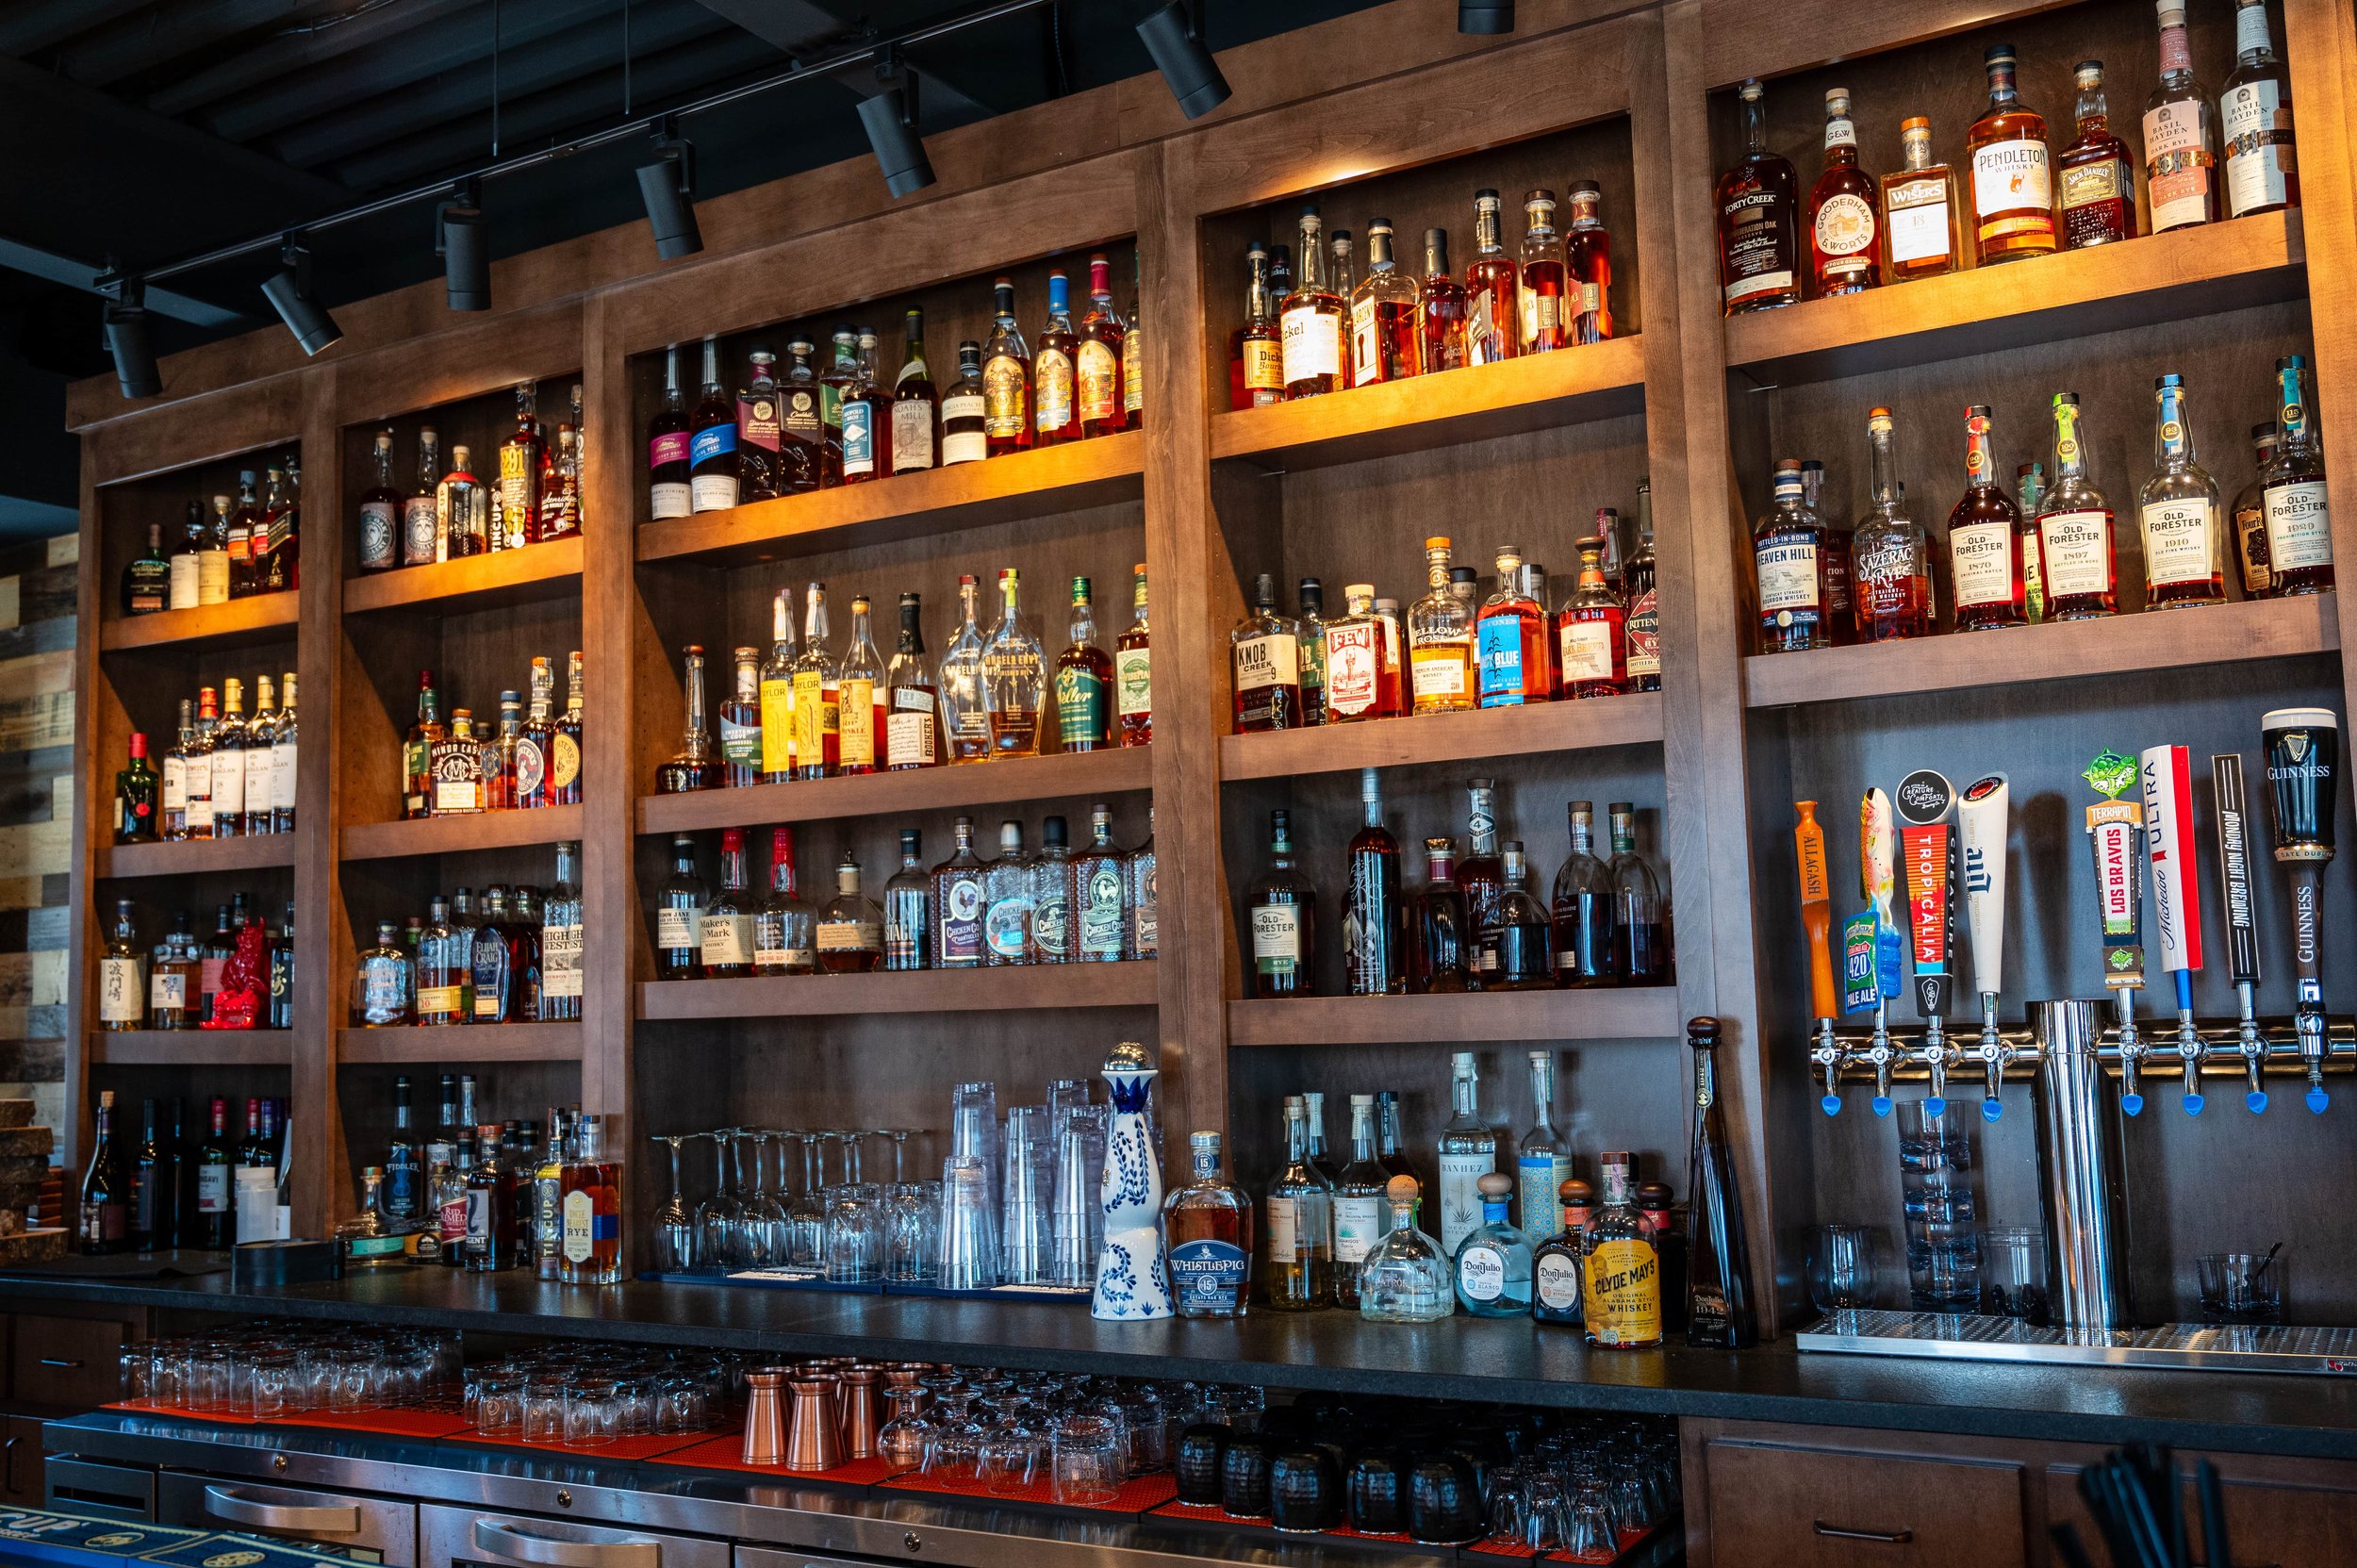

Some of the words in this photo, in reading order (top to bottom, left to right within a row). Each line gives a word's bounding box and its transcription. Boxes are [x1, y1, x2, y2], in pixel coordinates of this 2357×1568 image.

[2231, 102, 2261, 115] BASIL
[2228, 107, 2266, 124] HAYDEN
[2152, 121, 2182, 134] BASIL
[1827, 130, 1850, 140] G&W
[2150, 127, 2187, 143] HAYDEN
[2151, 143, 2168, 155] DARK
[2172, 139, 2188, 147] RYE
[1980, 147, 2046, 172] PENDLETON
[1995, 164, 2035, 173] WHISKY
[2069, 171, 2084, 185] JACK
[2178, 187, 2195, 196] RYE
[1725, 199, 1747, 215] FORTY
[1747, 194, 1774, 205] CREEK
[1817, 197, 1871, 230] GOODERHAM
[1765, 221, 1777, 229] OAK
[1912, 215, 1924, 226] 18
[1822, 239, 1829, 248] &
[1830, 233, 1868, 251] WORTS
[1260, 352, 1282, 361] Dick
[502, 448, 524, 474] 291
[2287, 495, 2308, 504] OLD
[2164, 512, 2184, 521] OLD
[2272, 502, 2328, 518] FORESTER
[492, 503, 502, 553] TINCUP
[2064, 525, 2083, 534] OLD
[2150, 519, 2201, 533] FORESTER
[2287, 523, 2315, 533] 1920
[1968, 536, 1986, 545] OLD
[2050, 533, 2099, 545] FORESTER
[2165, 538, 2189, 548] 1910
[1956, 542, 2003, 555] FORESTER
[1757, 550, 1788, 566] HEAVEN
[1790, 548, 1813, 560] HILL
[2063, 552, 2088, 560] 1897
[1859, 548, 1913, 581] SAZERAC
[1629, 619, 1658, 629] RITTEN
[1415, 626, 1462, 636] ELLOW
[1333, 629, 1367, 651] FEW
[1238, 643, 1266, 667] KNOB
[1495, 651, 1519, 666] BLUE
[1244, 660, 1273, 672] CREEK
[1271, 667, 1277, 680] 9
[432, 745, 458, 757] MINOR
[461, 743, 482, 754] CAS
[2267, 765, 2330, 781] GUINNESS
[1903, 785, 1934, 800] CREATURE
[1909, 794, 1946, 805] COMFORTS
[2144, 759, 2162, 845] ULTRA
[2091, 805, 2133, 821] TERRAPIN
[1474, 820, 1481, 829] 4
[2222, 810, 2242, 855] MONDAY
[2106, 828, 2124, 887] BRAVOS
[1803, 835, 1821, 896] ALLAGASH
[1966, 847, 1992, 894] Lite
[2228, 851, 2246, 881] NIGHT
[2112, 889, 2125, 915] LOS
[2230, 881, 2250, 928] BREWING
[998, 906, 1021, 917] CHICKE
[2160, 869, 2175, 950] Michelob
[701, 918, 730, 929] Maker's
[1262, 915, 1278, 923] OLD
[2297, 886, 2314, 964] GUINNESS
[707, 929, 730, 938] Mark
[947, 925, 971, 938] CHICKEN
[1086, 923, 1112, 936] CHICKEN
[1140, 921, 1157, 933] CHICK
[1254, 923, 1294, 933] FORESTER
[544, 932, 569, 941] HIGH
[475, 951, 498, 964] CRAIG
[1850, 954, 1867, 978] 420
[421, 999, 431, 1008] 10
[1848, 991, 1860, 1007] PALE
[1860, 988, 1876, 1003] ALE
[387, 1163, 420, 1172] FIDDLER
[1199, 1158, 1208, 1167] 15
[1442, 1164, 1483, 1173] BANHEZ
[441, 1212, 467, 1222] REMED
[543, 1199, 553, 1257] TINCUP
[567, 1229, 588, 1237] RYE
[1170, 1259, 1244, 1272] WHISTLEPIG
[1595, 1272, 1626, 1295] CLYDE
[1629, 1259, 1655, 1282] MAY'S
[1203, 1280, 1211, 1290] 15
[1608, 1303, 1653, 1312] WHISKEY
[1606, 1333, 1616, 1343] 85
